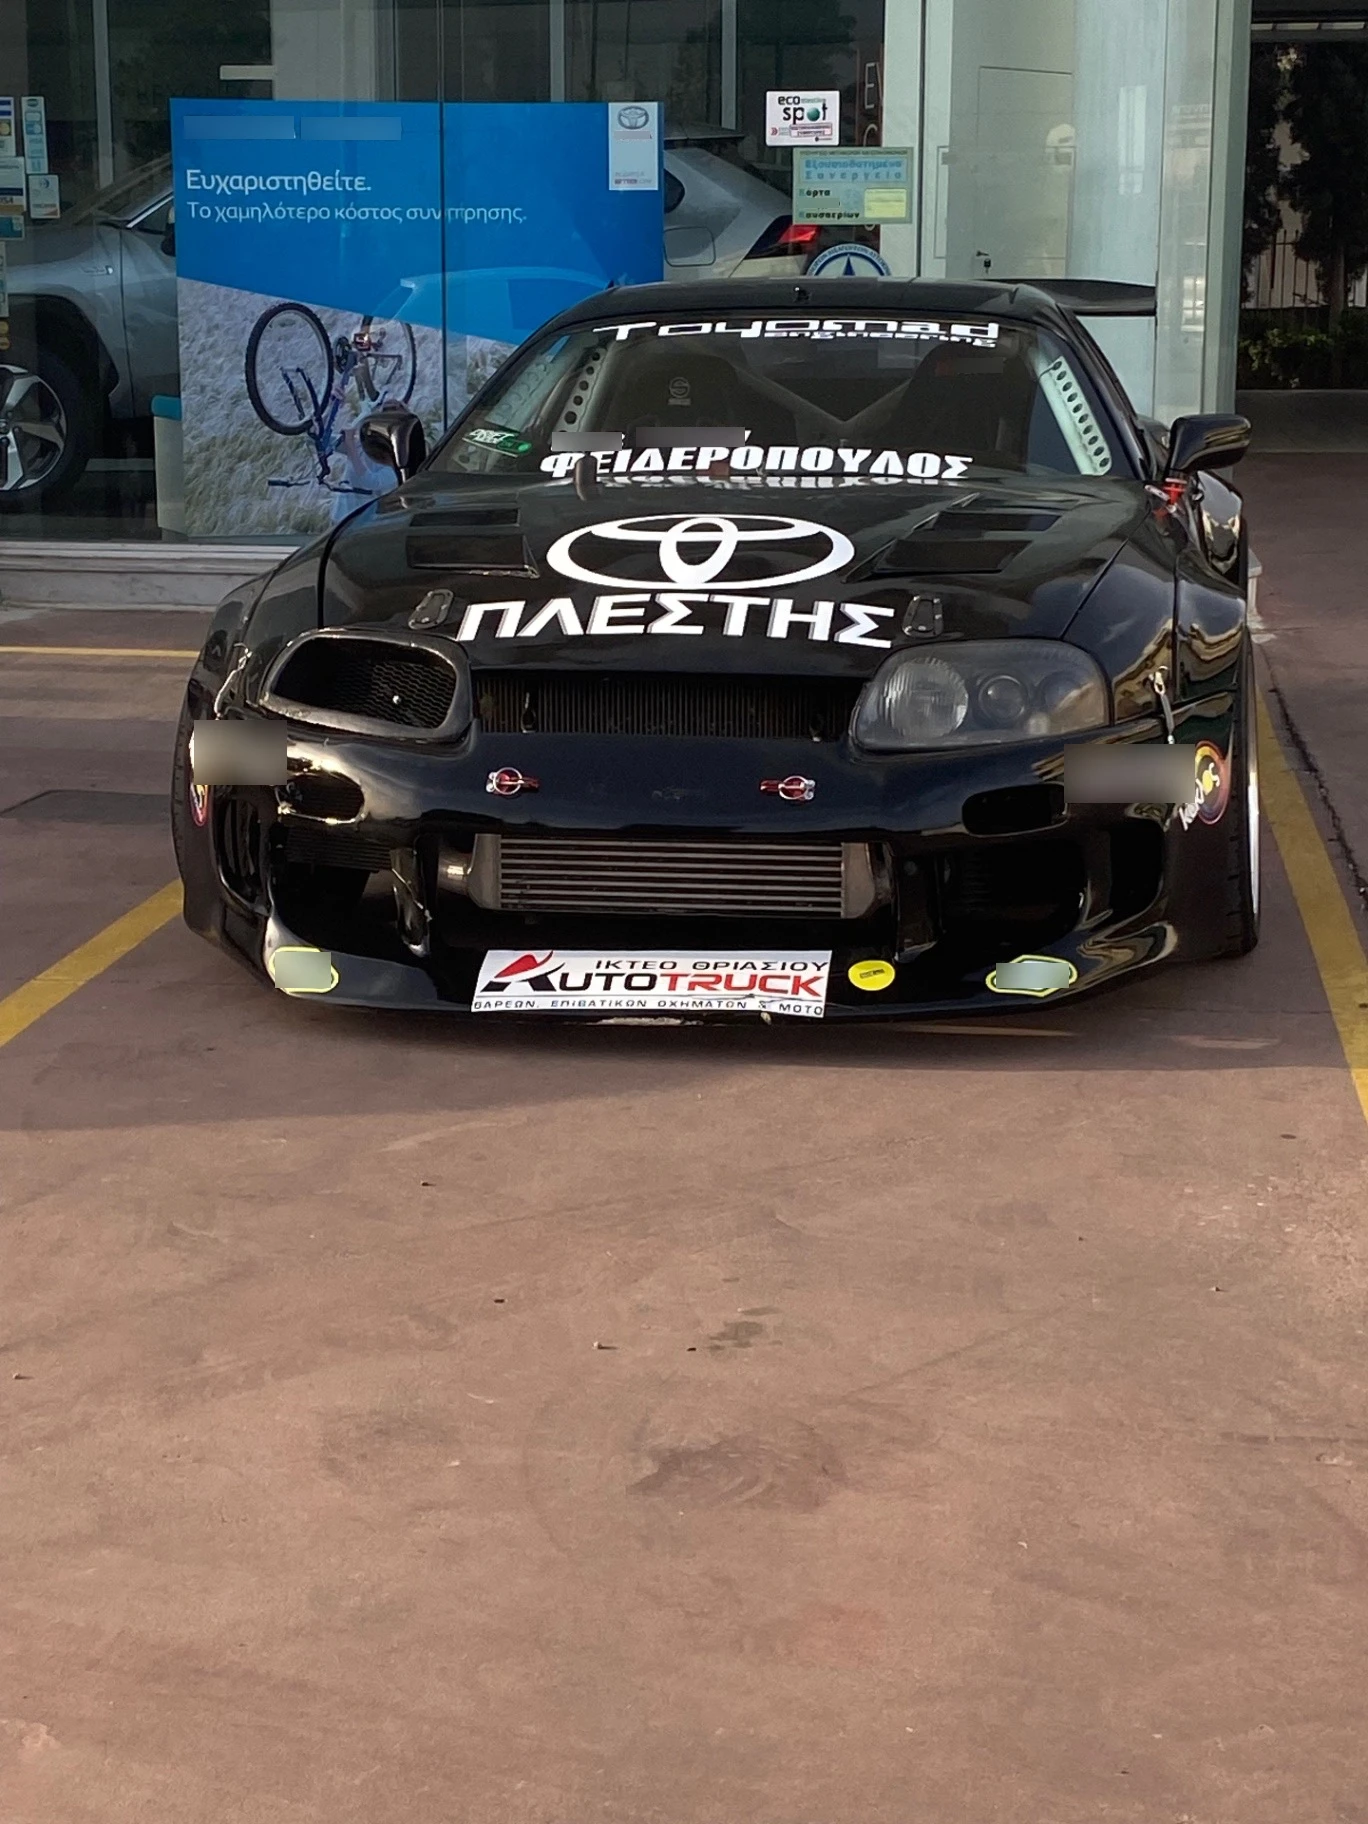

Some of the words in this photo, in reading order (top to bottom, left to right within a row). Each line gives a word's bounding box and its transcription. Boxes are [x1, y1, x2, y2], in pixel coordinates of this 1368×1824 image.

[778, 96, 801, 105] eco
[783, 102, 828, 125] spot
[186, 169, 372, 196] Ευχαριστηθείτε.
[187, 201, 212, 219] Το
[215, 201, 331, 224] χαμηλότερο
[335, 201, 403, 224] κόστος
[456, 593, 895, 648] ΠΛΕΣΤΗΣ
[595, 960, 678, 970] ΙΚΤΕΟ
[692, 961, 829, 972] ΘΡΙΑΣΙΟΥ
[551, 1000, 647, 1009] ΕΠΙΒΑΤΙΚΩΝ
[657, 1000, 747, 1009] ΟΧΗΜΑΤΩΝ
